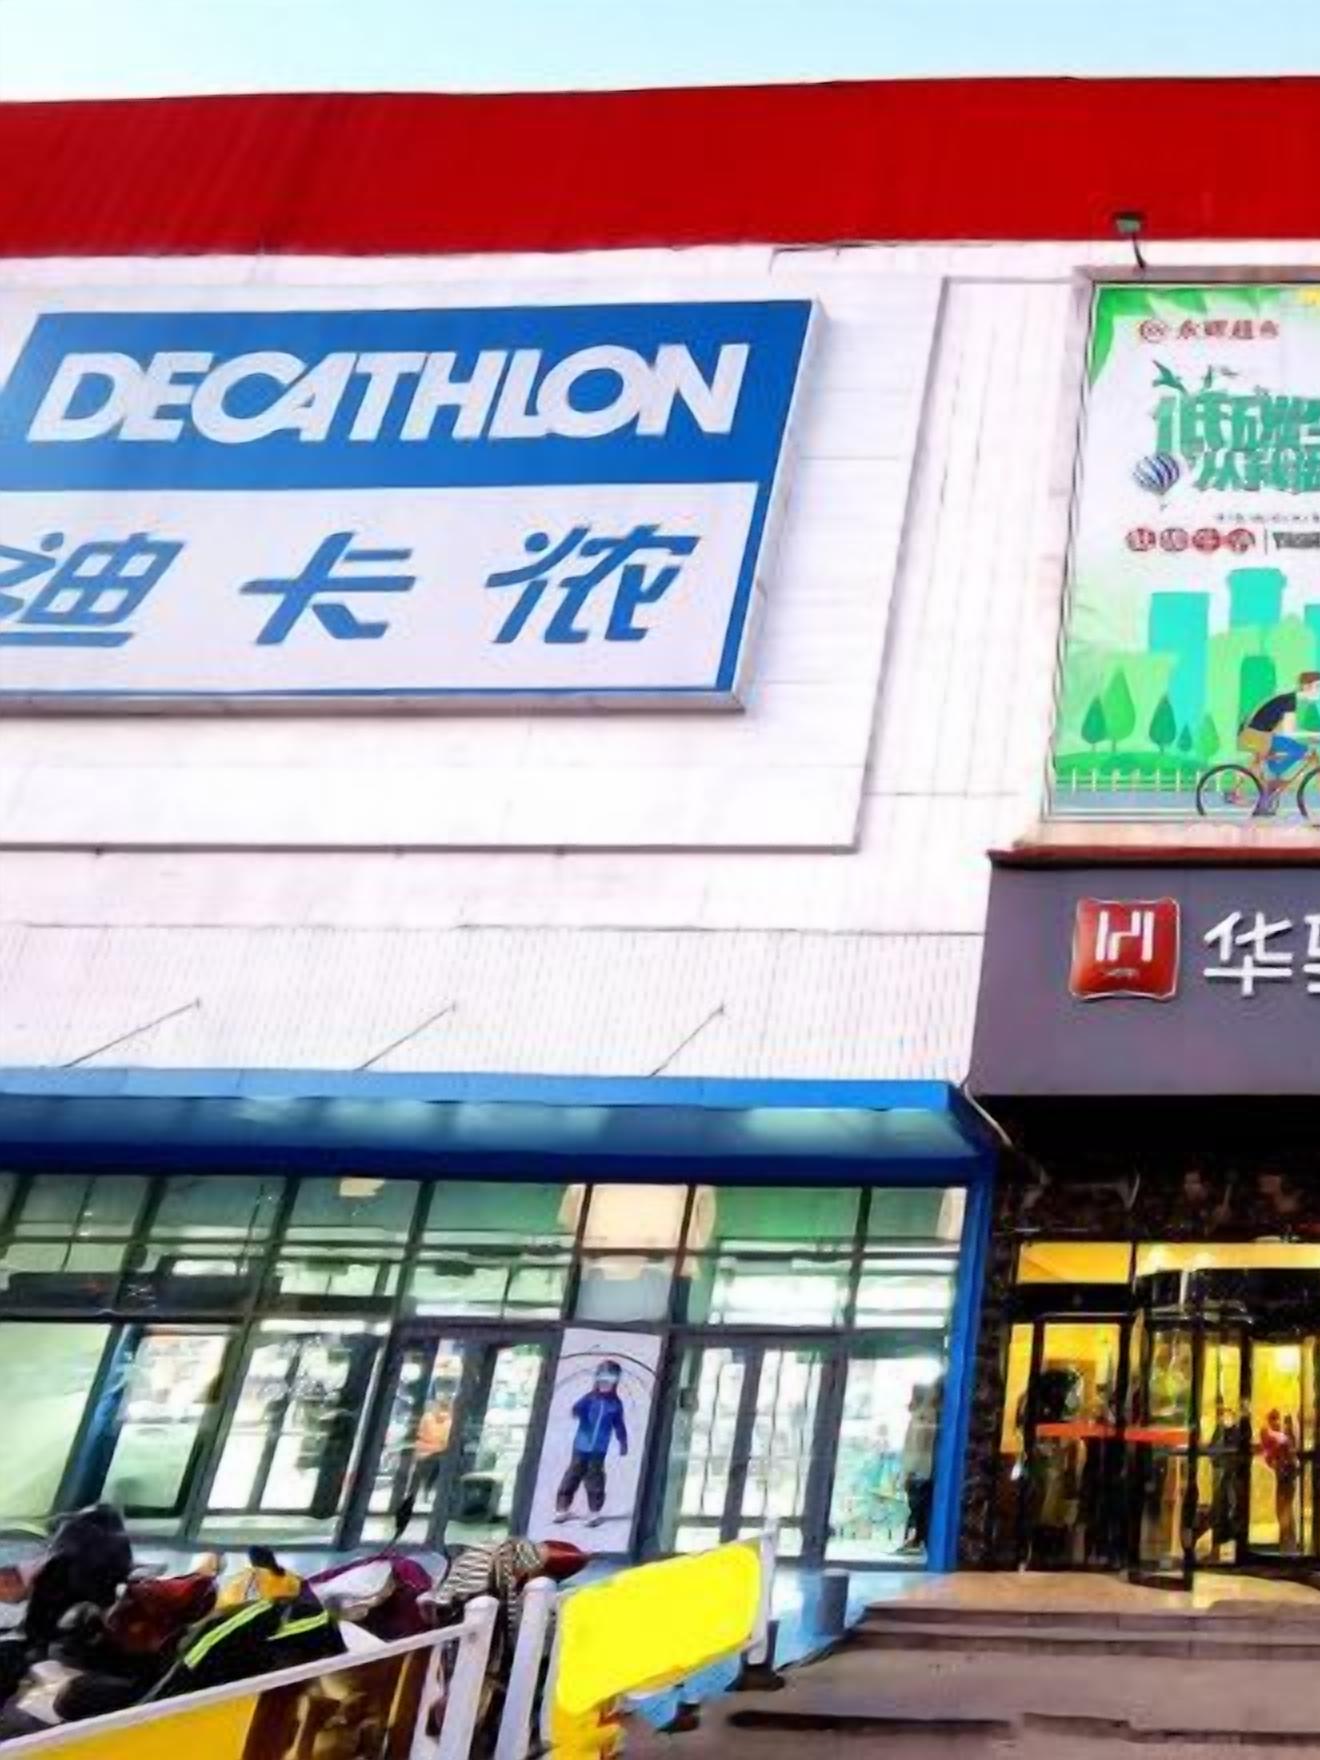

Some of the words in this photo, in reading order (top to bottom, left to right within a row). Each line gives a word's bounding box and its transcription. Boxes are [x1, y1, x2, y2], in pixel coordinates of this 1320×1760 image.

[27, 343, 750, 445] DECATHLON
[0, 524, 700, 647] 迪卡侬
